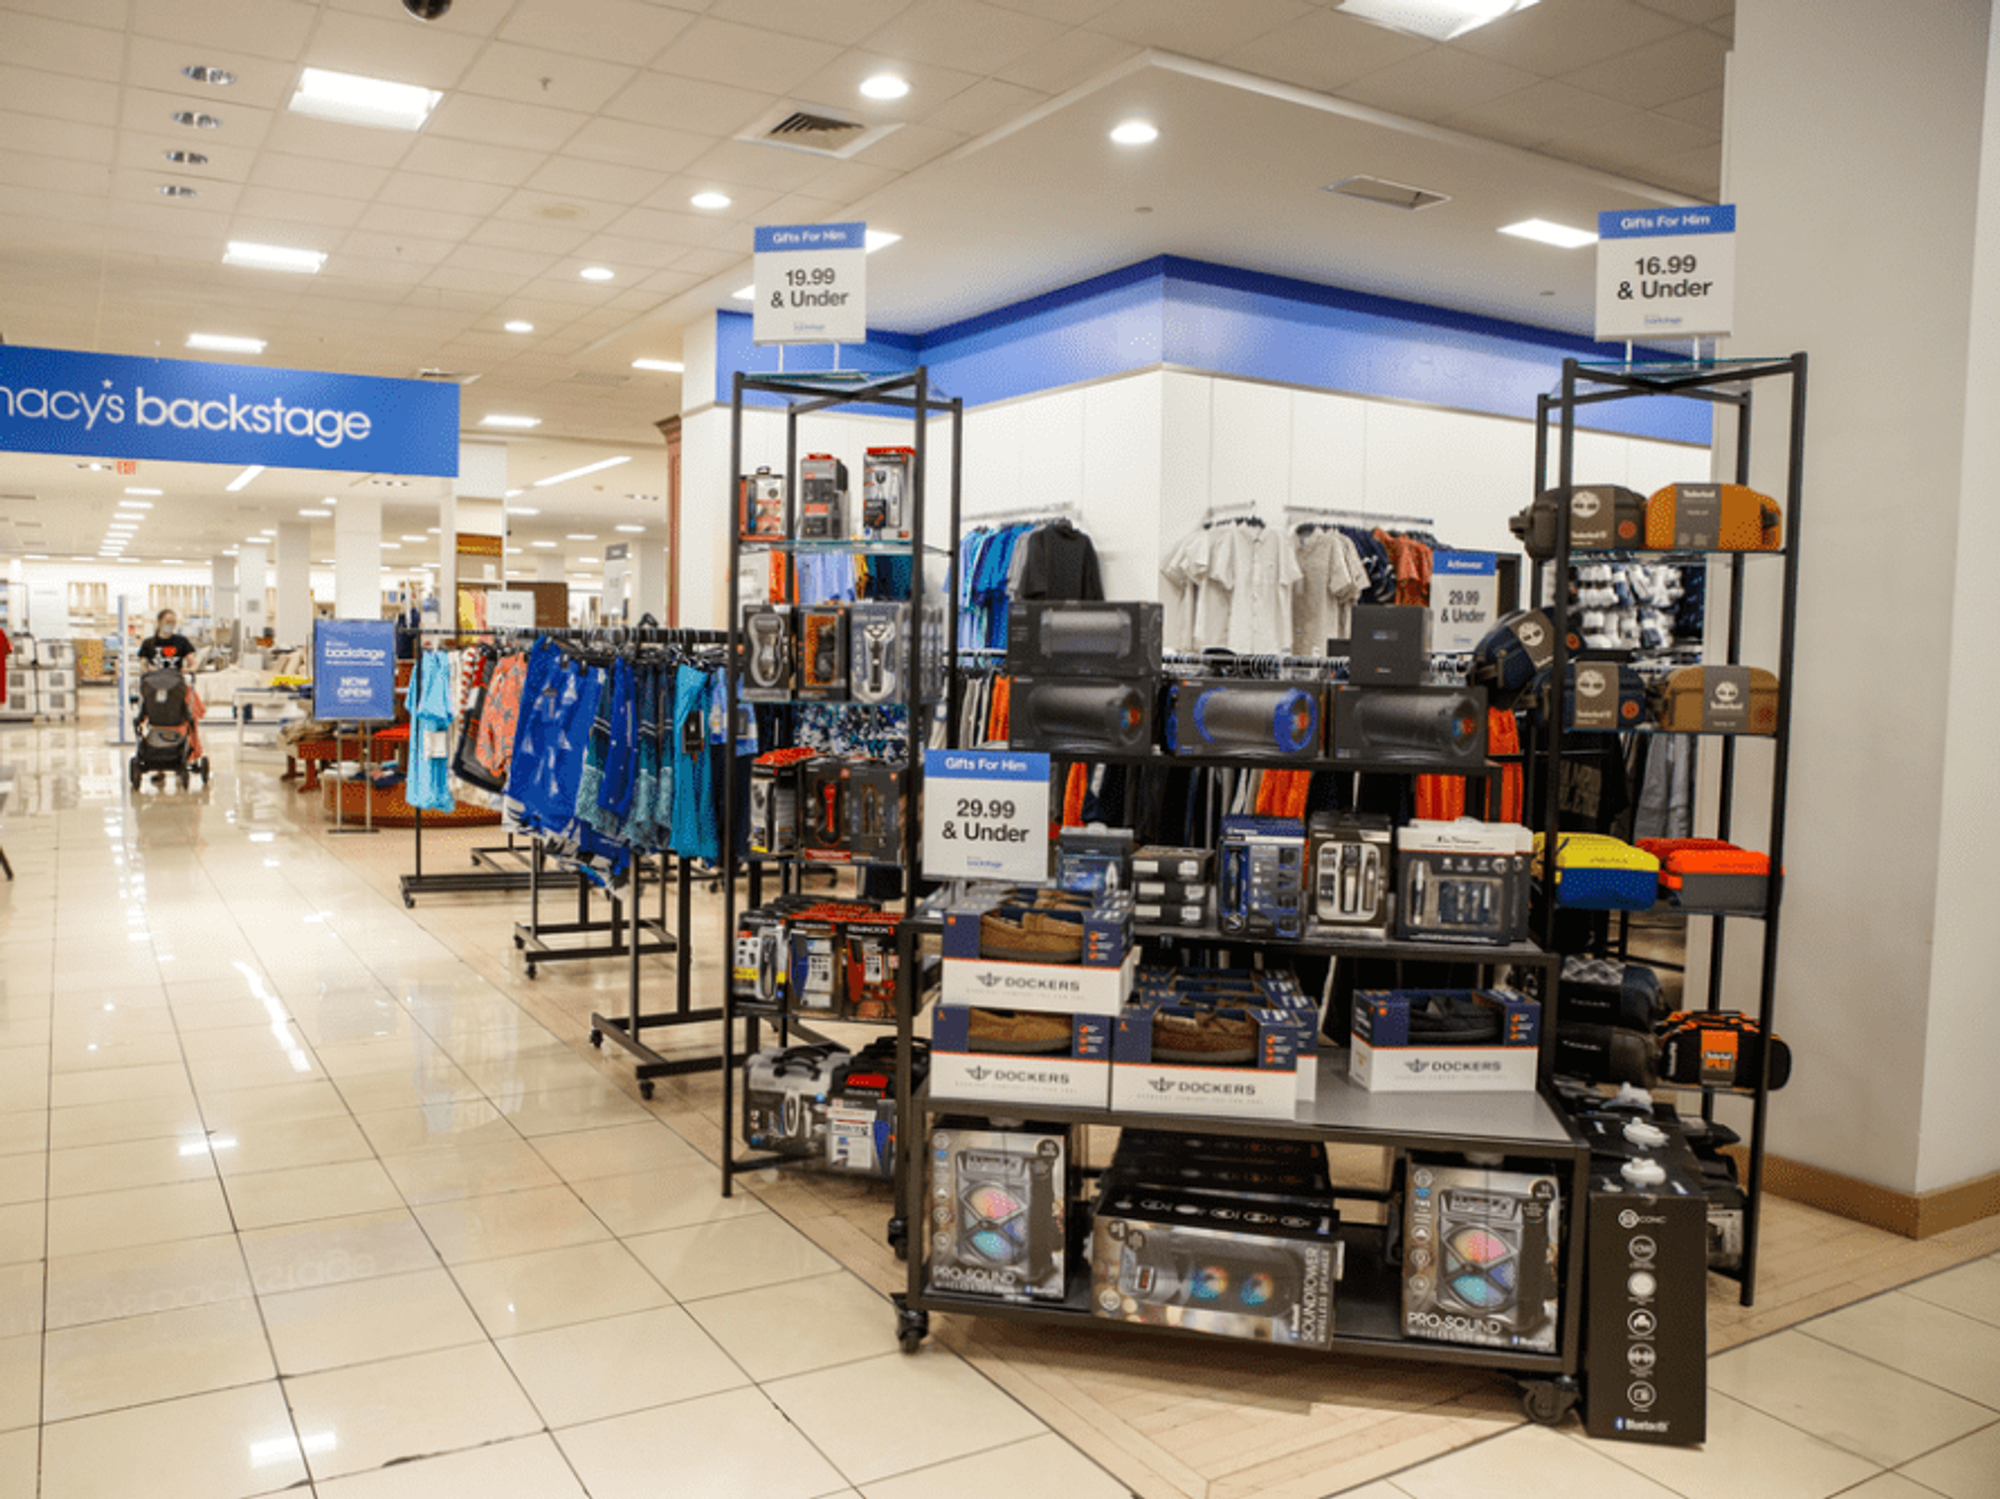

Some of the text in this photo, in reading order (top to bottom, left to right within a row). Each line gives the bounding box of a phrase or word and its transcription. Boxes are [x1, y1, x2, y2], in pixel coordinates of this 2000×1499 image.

[1621, 214, 1711, 230] Gifts For Him
[773, 229, 847, 245] Gifts For Him
[1635, 254, 1697, 276] 16.99
[785, 267, 836, 287] 19.99
[1617, 279, 1713, 300] & Under
[771, 289, 849, 308] & Under
[136, 386, 371, 448] backstage
[1449, 591, 1480, 605] 29.99
[1441, 608, 1486, 623] & Under
[945, 757, 1027, 772] Gifts For Him
[957, 799, 1016, 818] 29.99
[942, 821, 1030, 842] & Under
[1004, 976, 1080, 992] DOCKERS
[1431, 1060, 1502, 1072] DOCKERS
[995, 1070, 1070, 1084] DOCKERS
[1178, 1080, 1256, 1096] DOCKERS
[1301, 1247, 1318, 1342] SOUNDTOWER
[1408, 1311, 1501, 1335] PRO-SOUND
